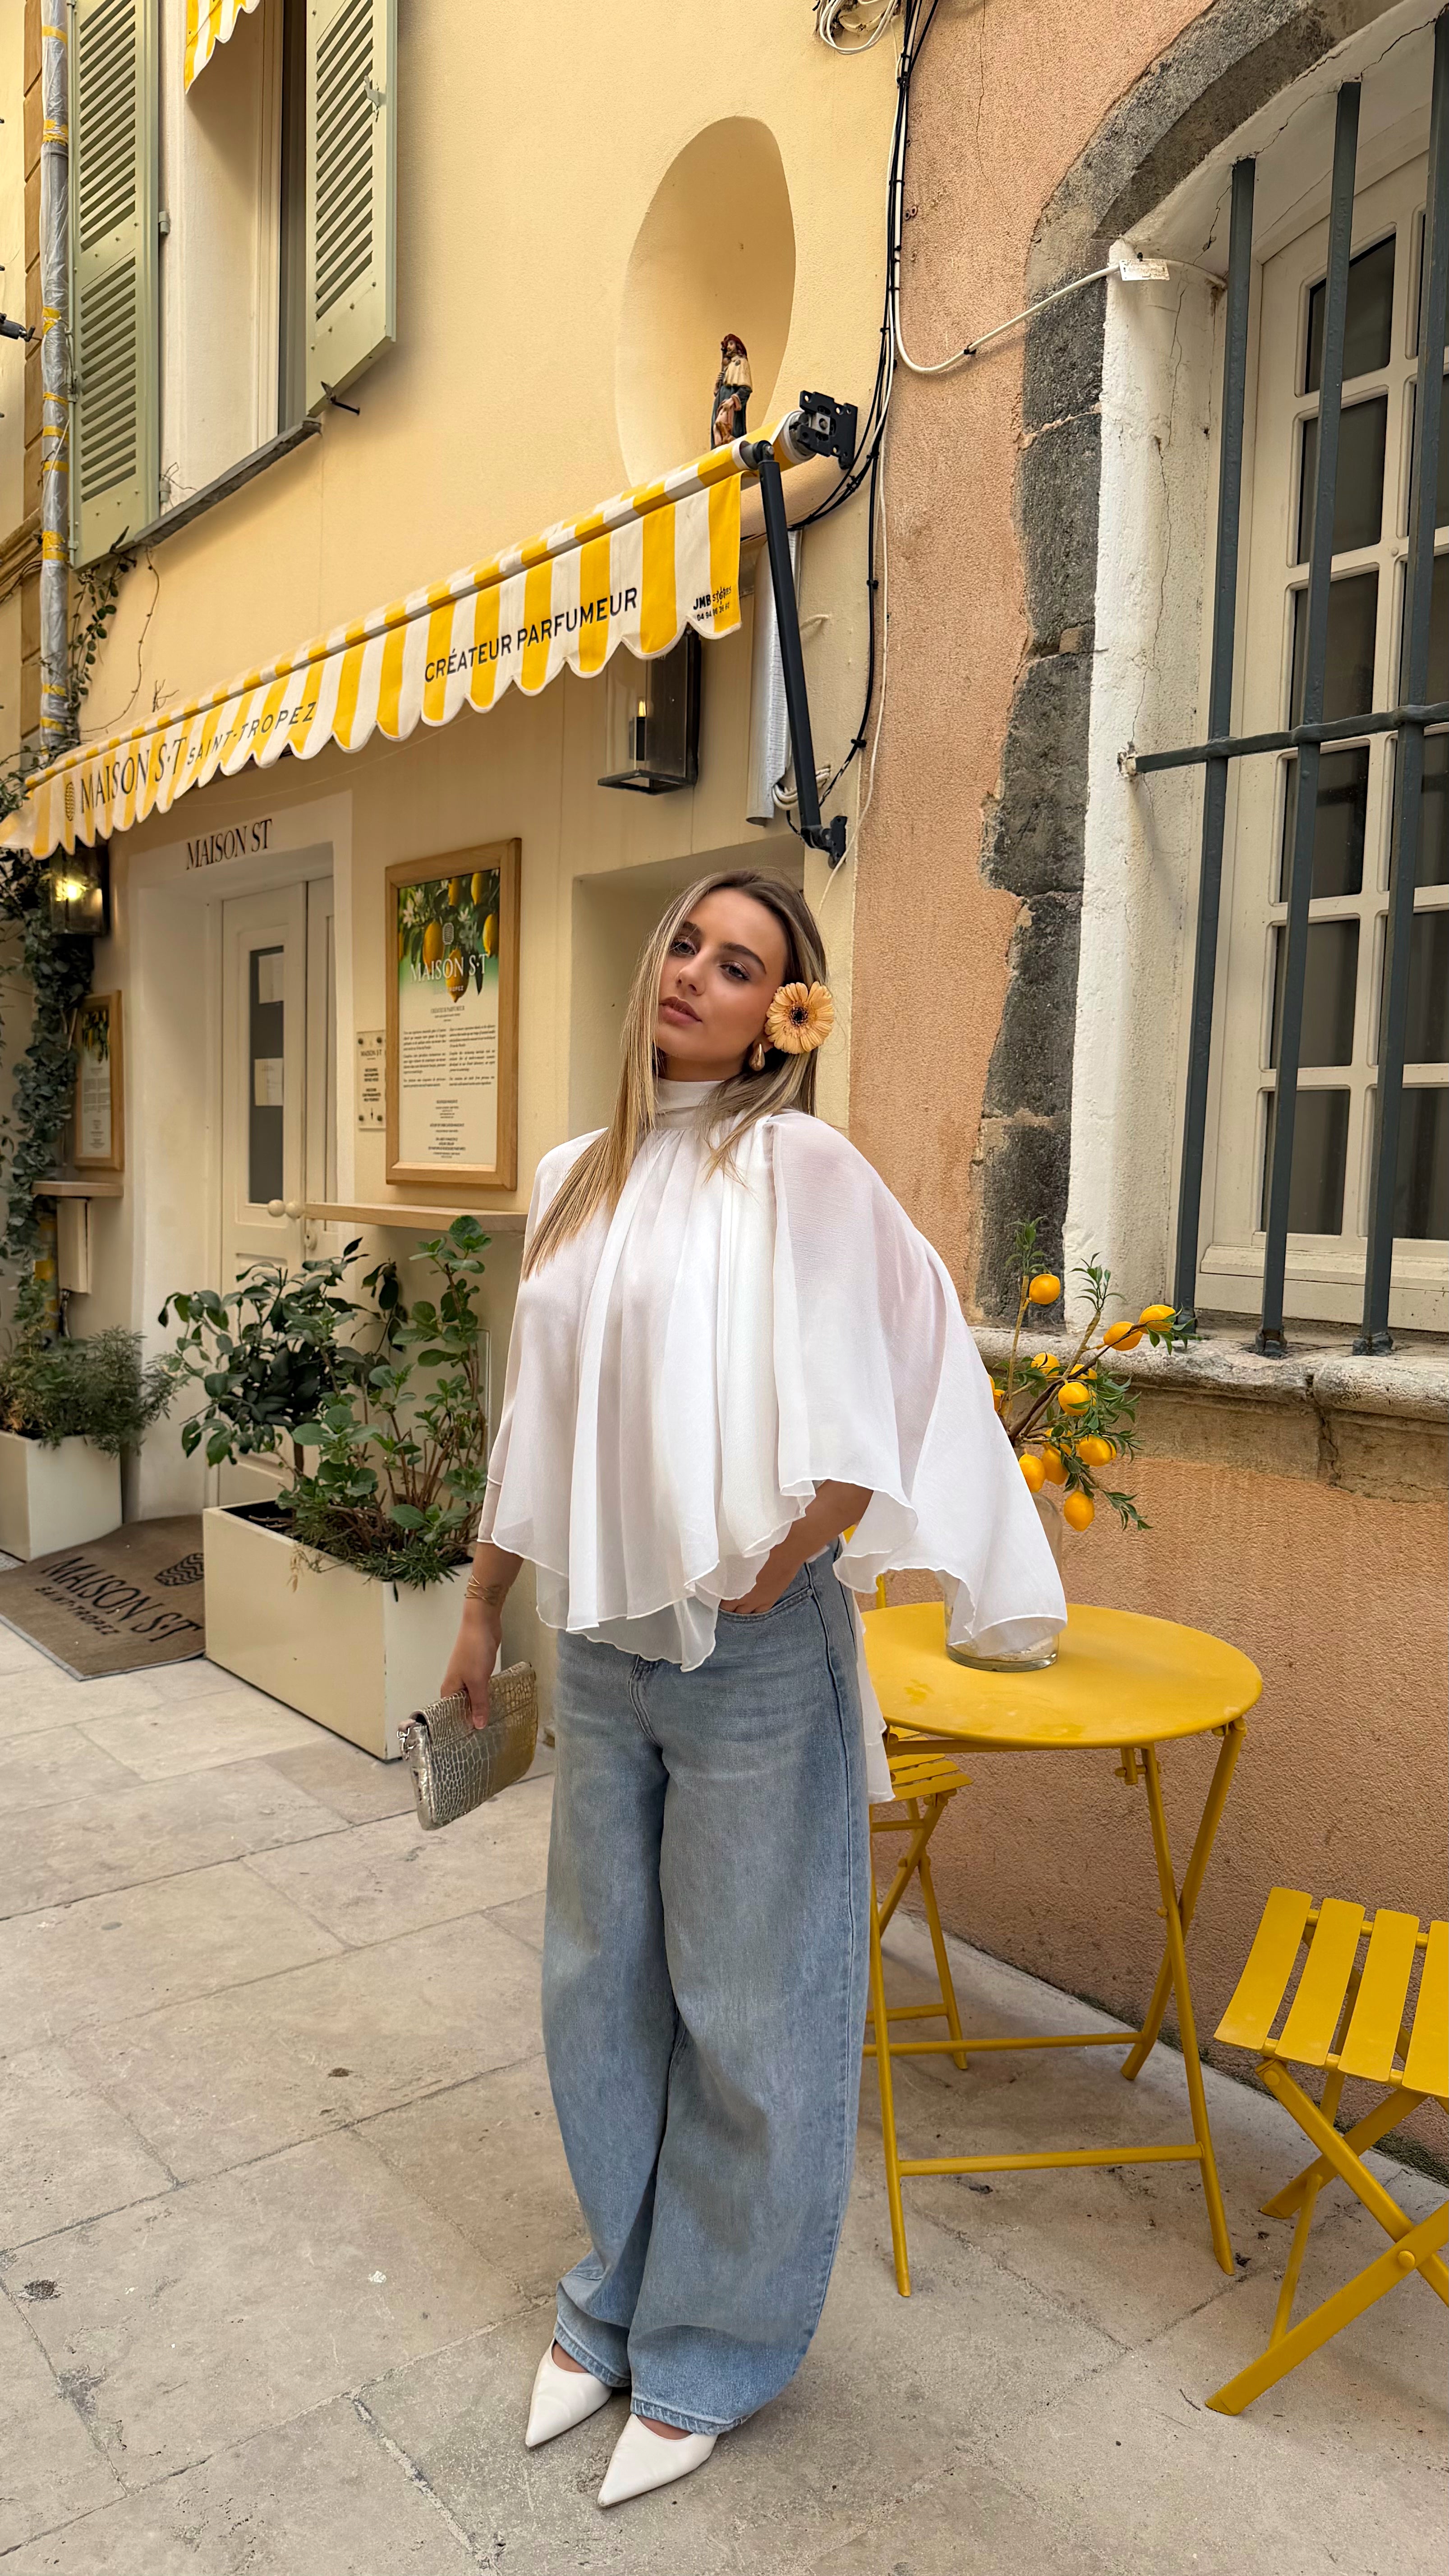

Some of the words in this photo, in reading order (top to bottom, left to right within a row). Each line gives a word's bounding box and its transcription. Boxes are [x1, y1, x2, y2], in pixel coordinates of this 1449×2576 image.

[693, 594, 711, 610] JMB
[424, 634, 511, 683] CRÉATEUR
[517, 587, 638, 651] PARFUMEUR
[81, 749, 150, 814] MAISON
[187, 702, 317, 765] SAINT-TROPEZ
[186, 826, 247, 870] MAISON
[252, 819, 272, 852] ST
[410, 956, 464, 982] MAISON
[40, 1556, 164, 1622] MAISON
